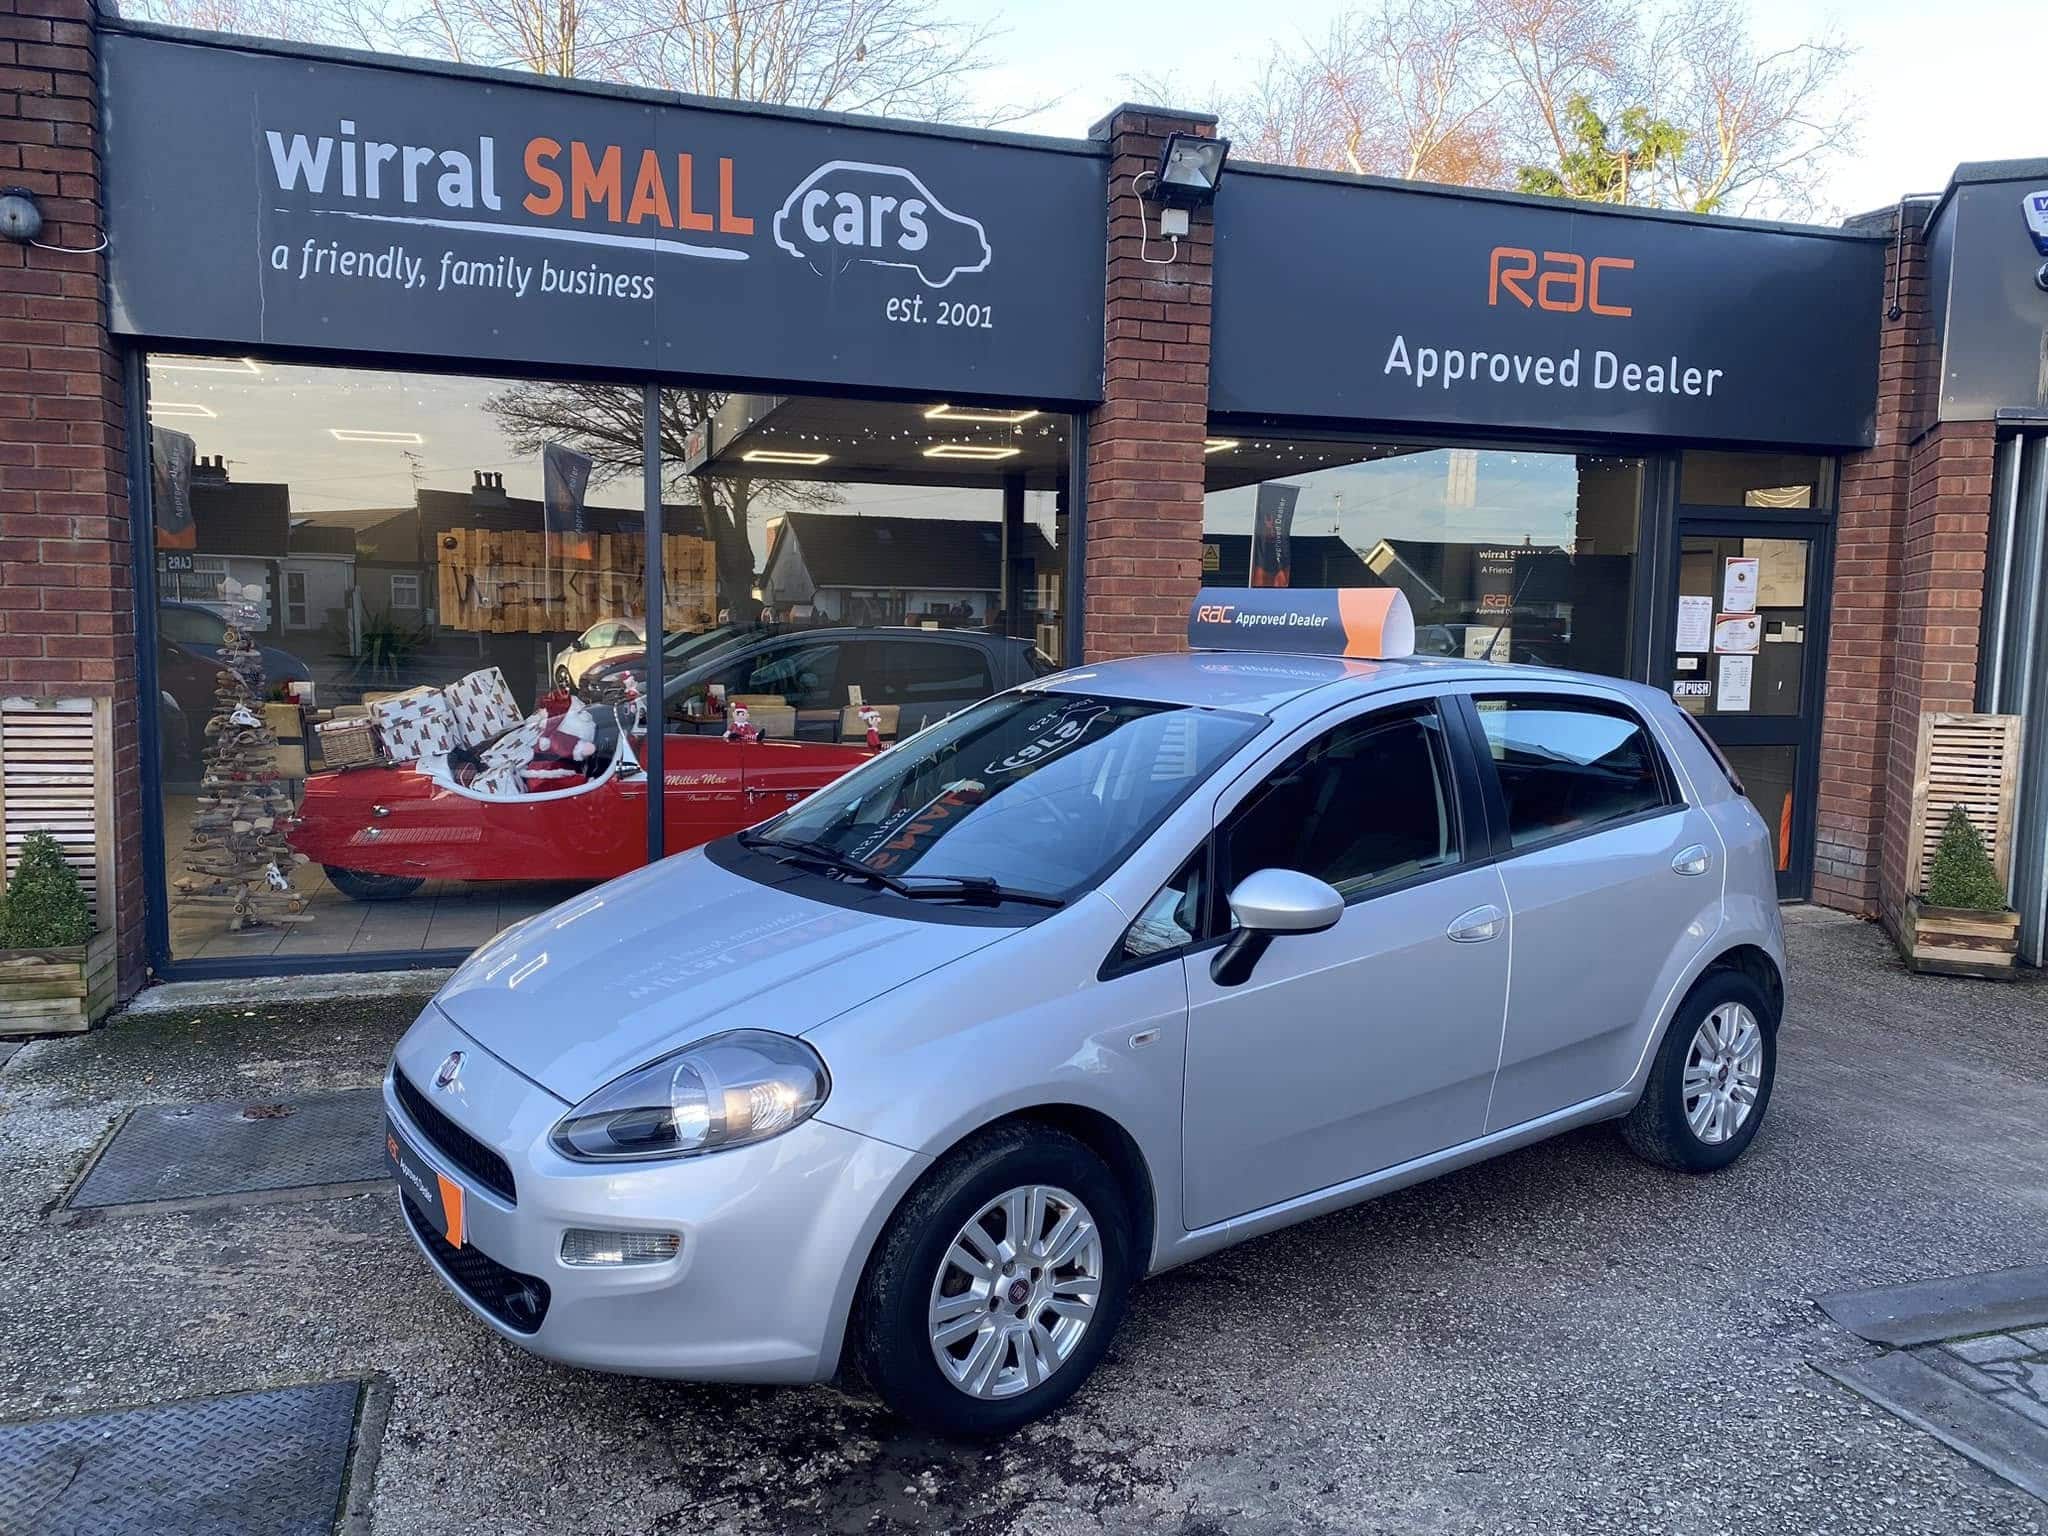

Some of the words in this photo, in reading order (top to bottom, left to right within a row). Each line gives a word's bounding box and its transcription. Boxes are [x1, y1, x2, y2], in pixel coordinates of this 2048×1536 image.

[265, 119, 502, 211] wirral
[522, 137, 754, 235] SMALL
[802, 189, 928, 251] cars
[271, 244, 289, 270] a
[298, 238, 426, 289] friendly,
[437, 251, 532, 298] family
[540, 259, 655, 300] business
[886, 294, 928, 324] est.
[936, 301, 993, 329] 2001
[1383, 334, 1580, 391] Approved
[1594, 350, 1724, 397] Dealer
[1479, 550, 1508, 559] wirral
[1235, 611, 1286, 628] Approved
[1289, 612, 1329, 627] Dealer
[1685, 682, 1709, 695] PUSH
[665, 774, 699, 786] Millie
[701, 774, 727, 785] Mac
